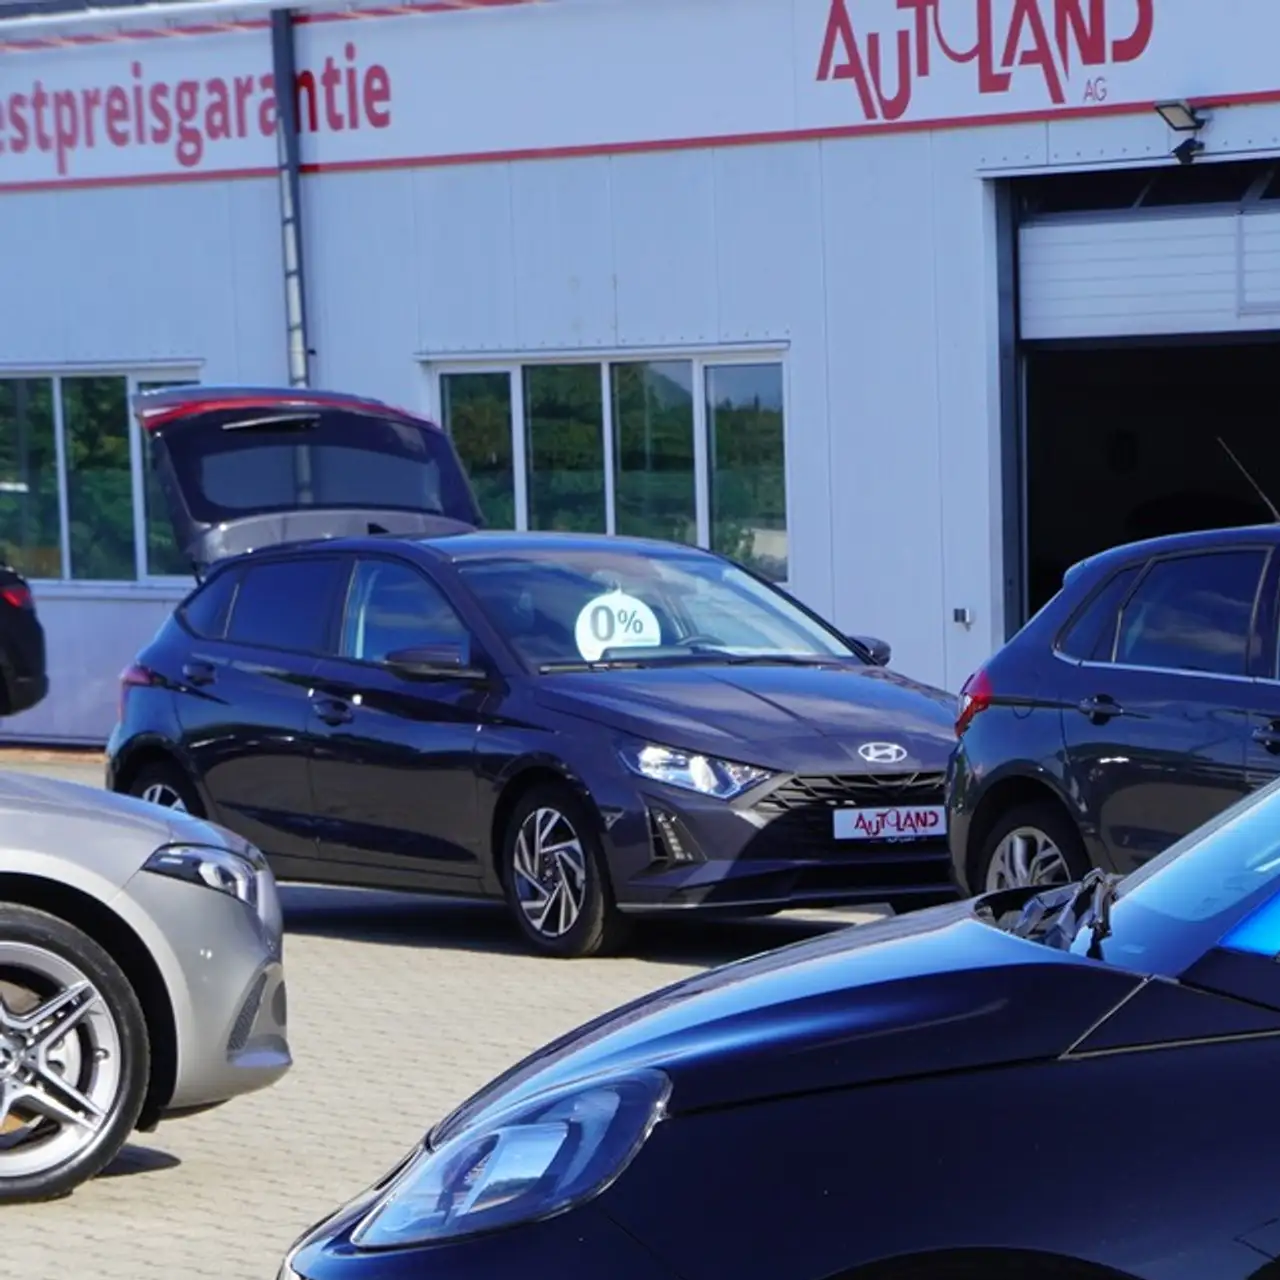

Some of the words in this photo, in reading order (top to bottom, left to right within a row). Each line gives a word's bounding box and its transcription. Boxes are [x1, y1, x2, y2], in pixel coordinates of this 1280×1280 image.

[1083, 77, 1108, 103] AG
[0, 42, 391, 175] stpreisgarantie
[590, 605, 644, 641] 0%
